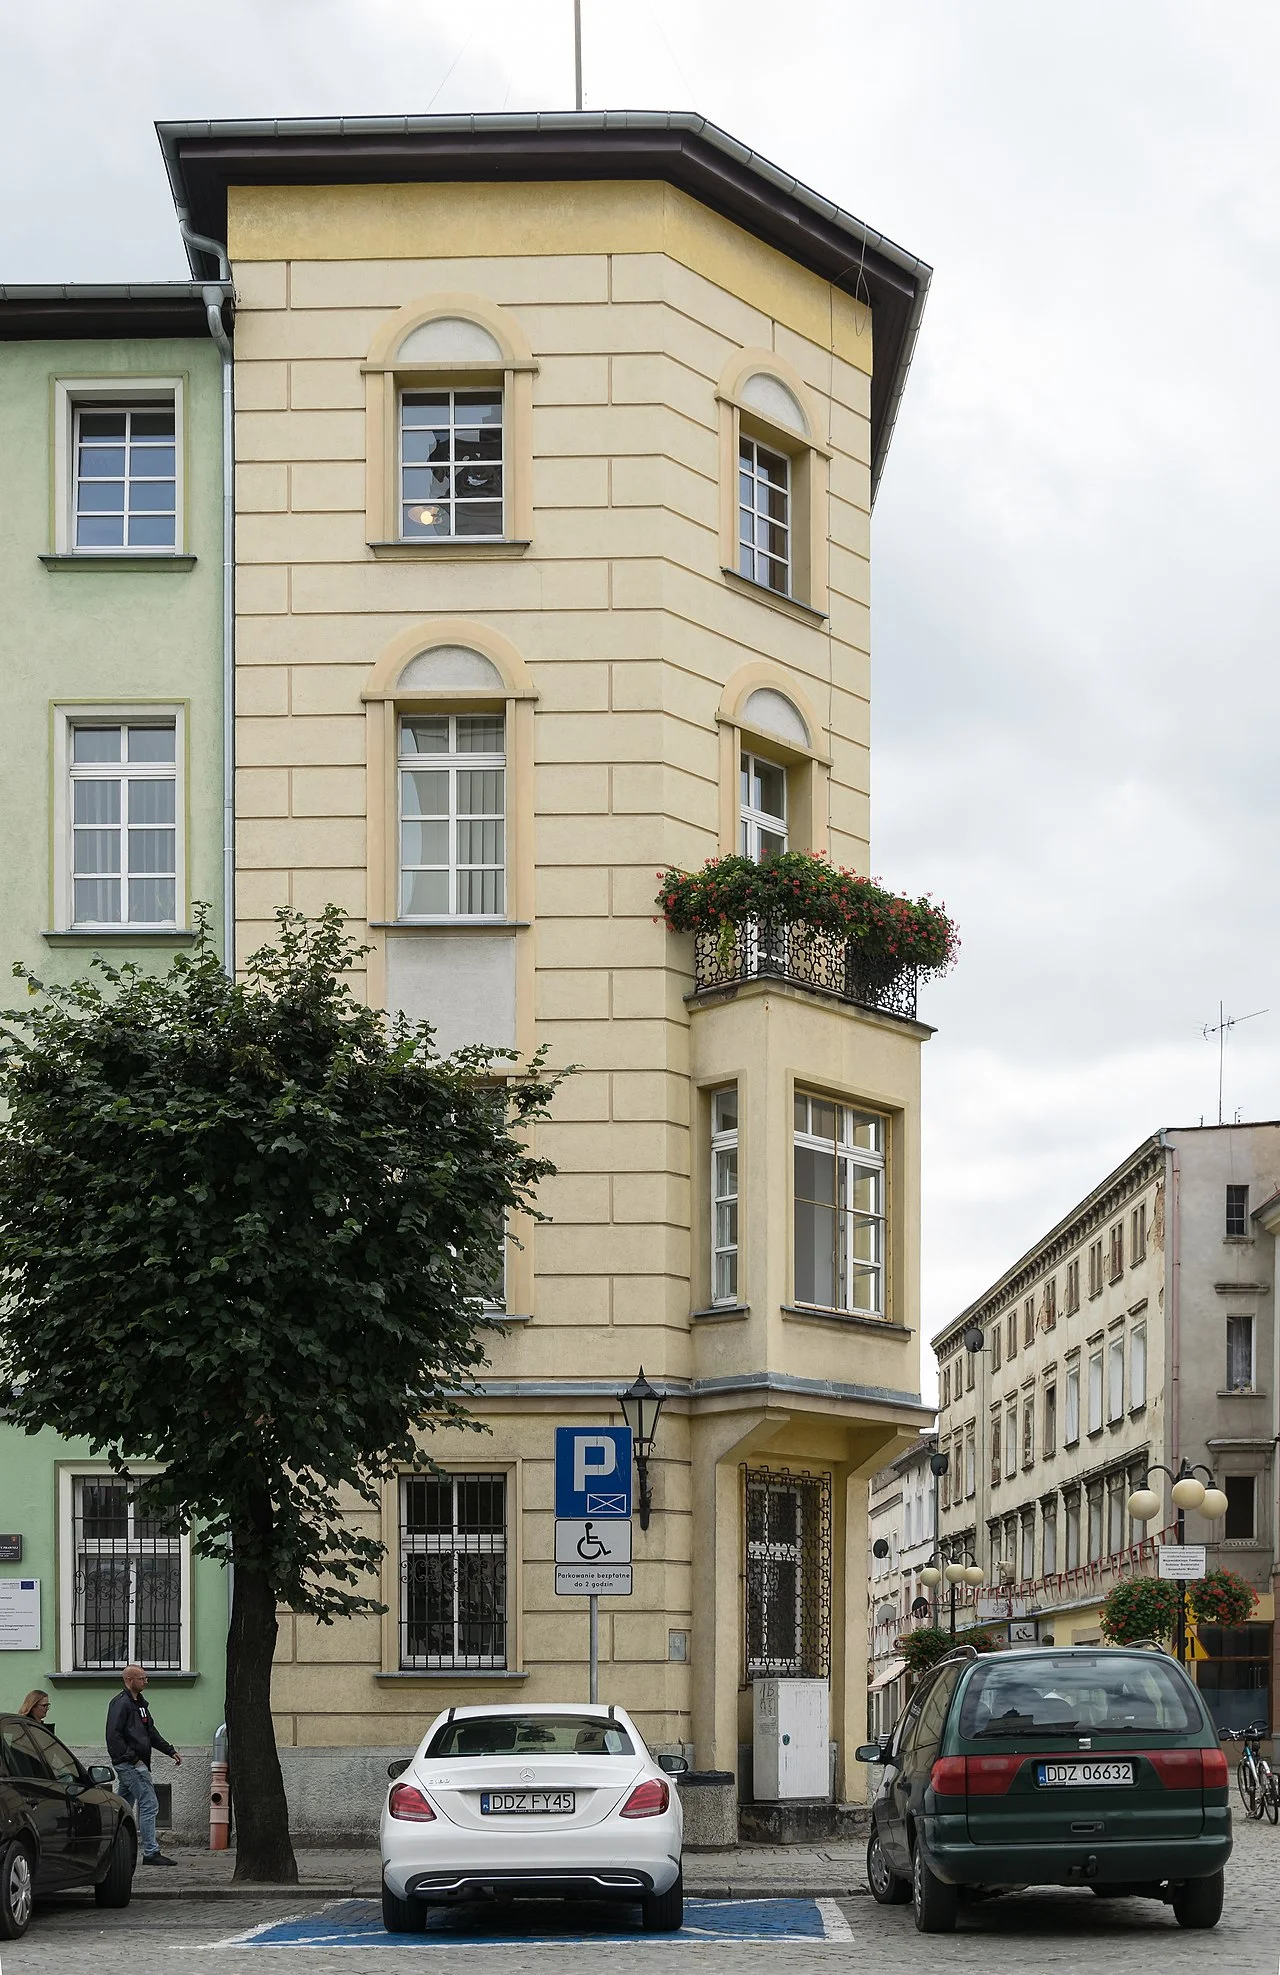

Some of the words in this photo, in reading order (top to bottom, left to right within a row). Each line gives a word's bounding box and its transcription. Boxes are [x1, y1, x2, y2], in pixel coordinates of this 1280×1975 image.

[573, 1435, 616, 1492] P
[596, 1572, 630, 1580] bezpłatne
[591, 1581, 614, 1589] godzin
[1047, 1766, 1077, 1782] DDZ
[1082, 1765, 1130, 1780] 06632
[492, 1794, 526, 1810] DDZ
[531, 1794, 571, 1809] FY45
